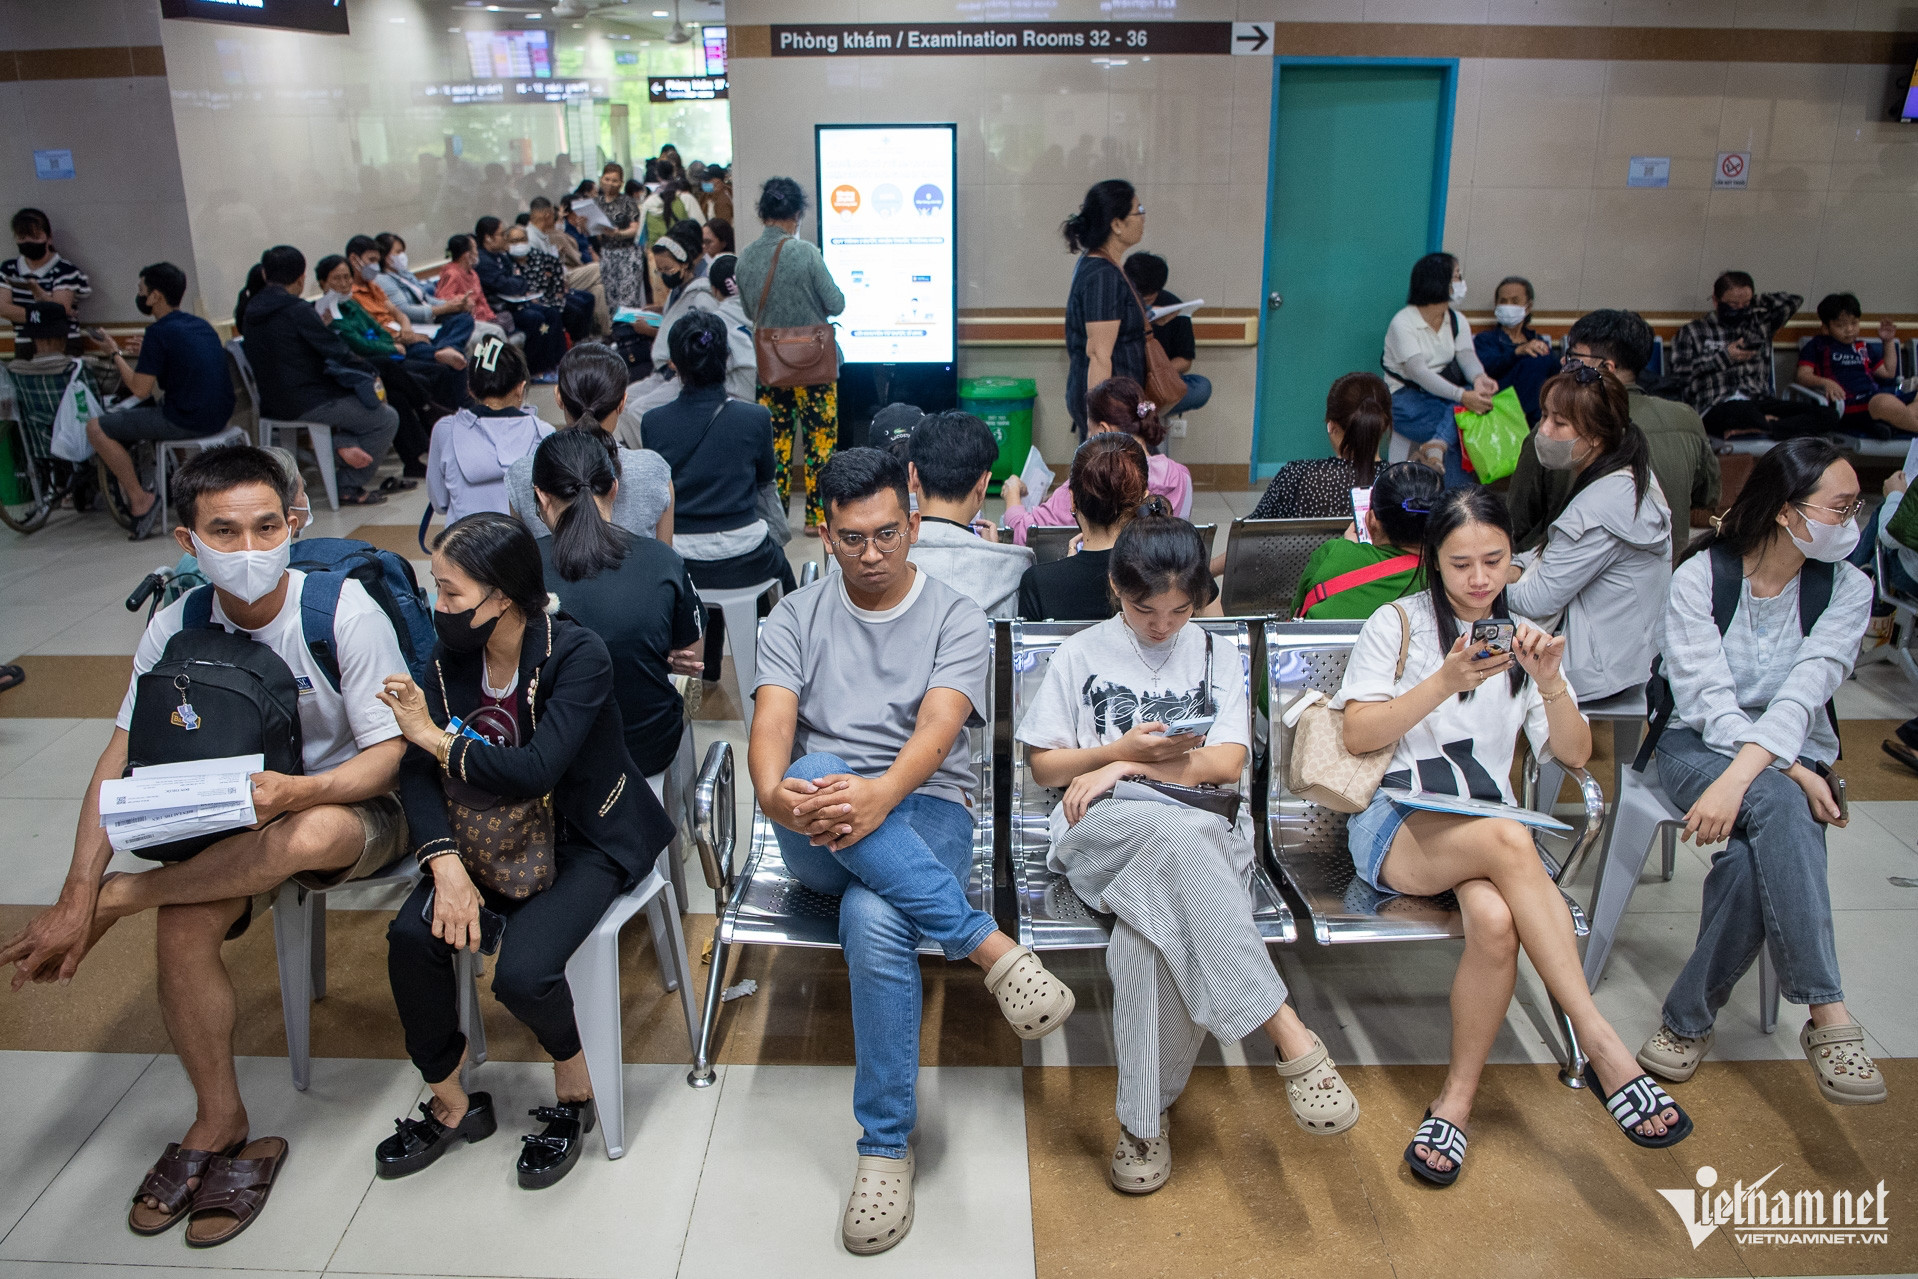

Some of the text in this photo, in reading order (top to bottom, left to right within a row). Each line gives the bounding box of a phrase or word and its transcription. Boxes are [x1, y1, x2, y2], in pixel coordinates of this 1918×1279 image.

[780, 32, 838, 52] Phòng
[843, 31, 892, 49] khám
[895, 31, 904, 49] /
[907, 29, 1017, 48] Examination
[1023, 29, 1085, 47] Rooms
[1089, 30, 1111, 47] 32
[1126, 30, 1148, 47] 36
